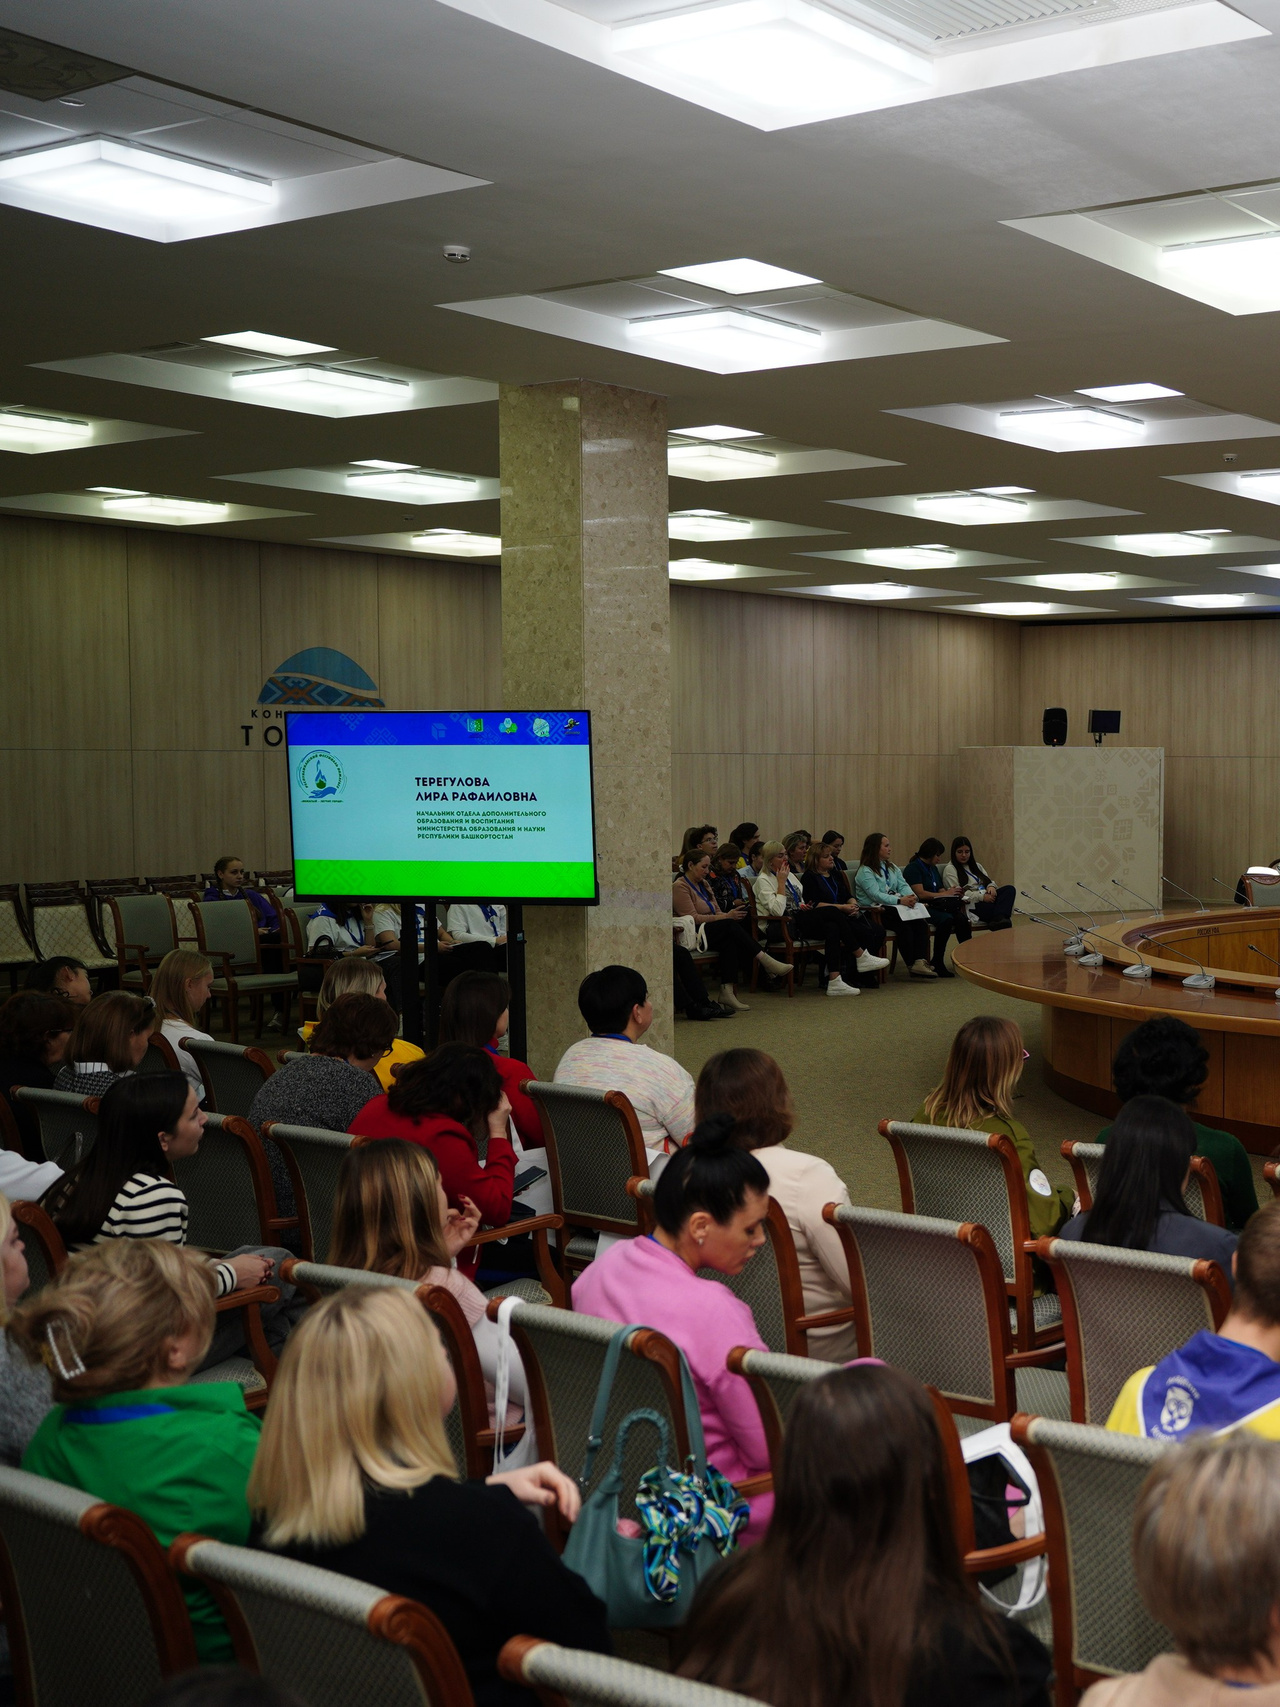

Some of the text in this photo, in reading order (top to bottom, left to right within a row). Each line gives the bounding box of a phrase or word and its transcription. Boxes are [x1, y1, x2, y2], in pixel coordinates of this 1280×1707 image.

[415, 777, 490, 787] ТЕРЕГУЛОВА
[415, 791, 538, 802] ЛИРА РАФАИЛОВНА
